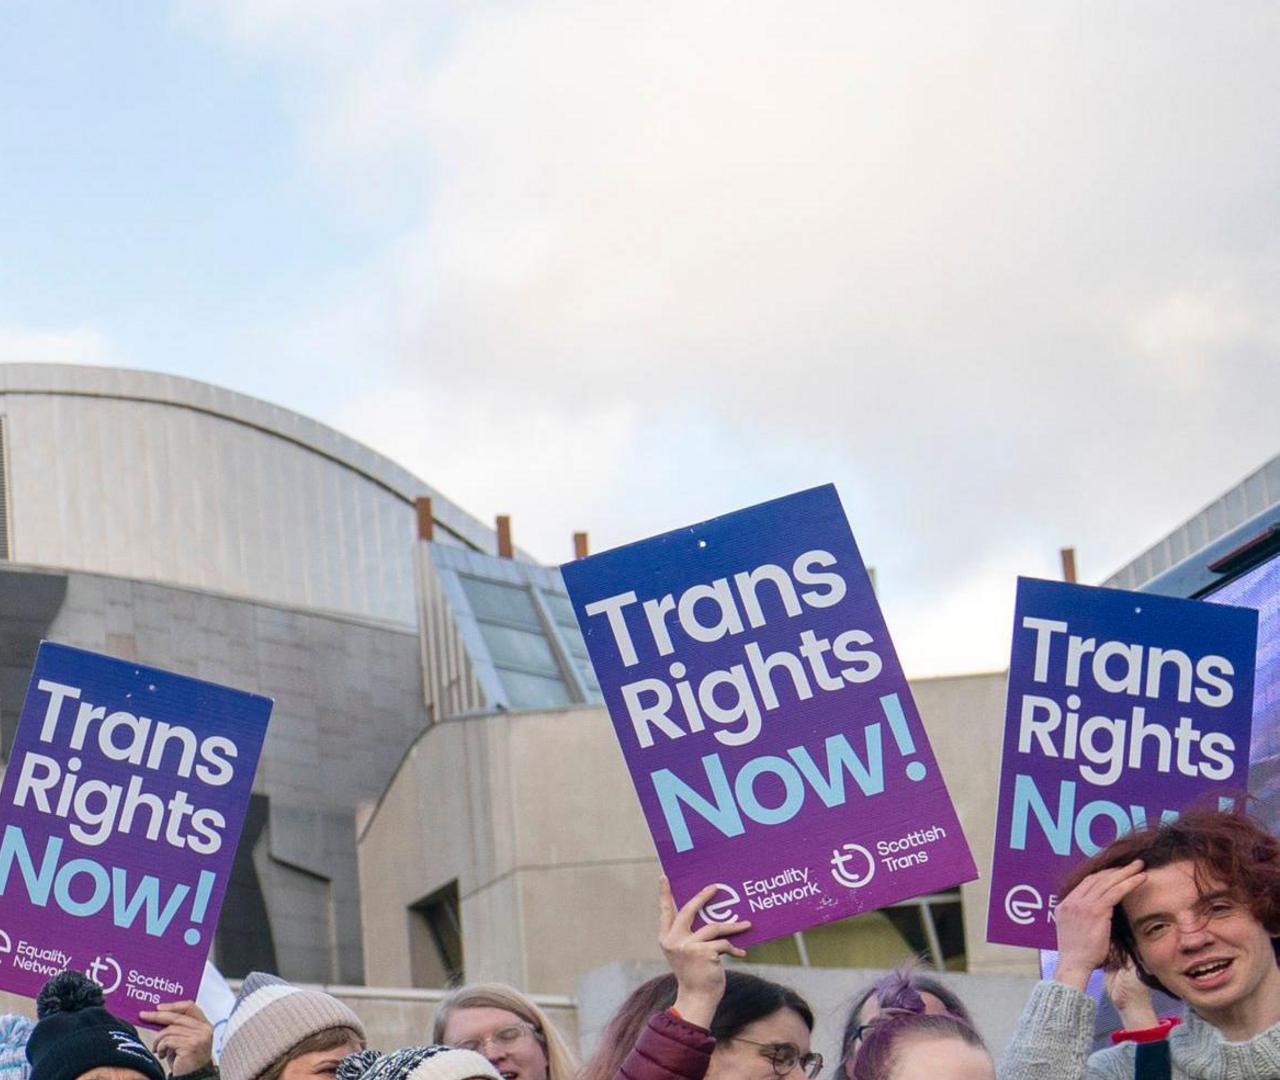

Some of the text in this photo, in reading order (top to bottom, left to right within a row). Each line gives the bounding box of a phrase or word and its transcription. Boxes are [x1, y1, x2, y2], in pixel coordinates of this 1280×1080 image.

[585, 549, 847, 667] Trans
[621, 629, 883, 748] Rights
[1022, 616, 1234, 708] Trans
[38, 679, 239, 786] Trans
[1018, 694, 1236, 786] Rights
[13, 751, 226, 854] Rights
[650, 692, 927, 853] Now!
[877, 825, 946, 857] Scottish
[881, 850, 929, 873] Trans
[743, 867, 809, 896] Equality
[749, 882, 821, 913] Network
[16, 940, 72, 968] Equality
[127, 970, 184, 995] Scottish
[125, 983, 161, 1004] Trans
